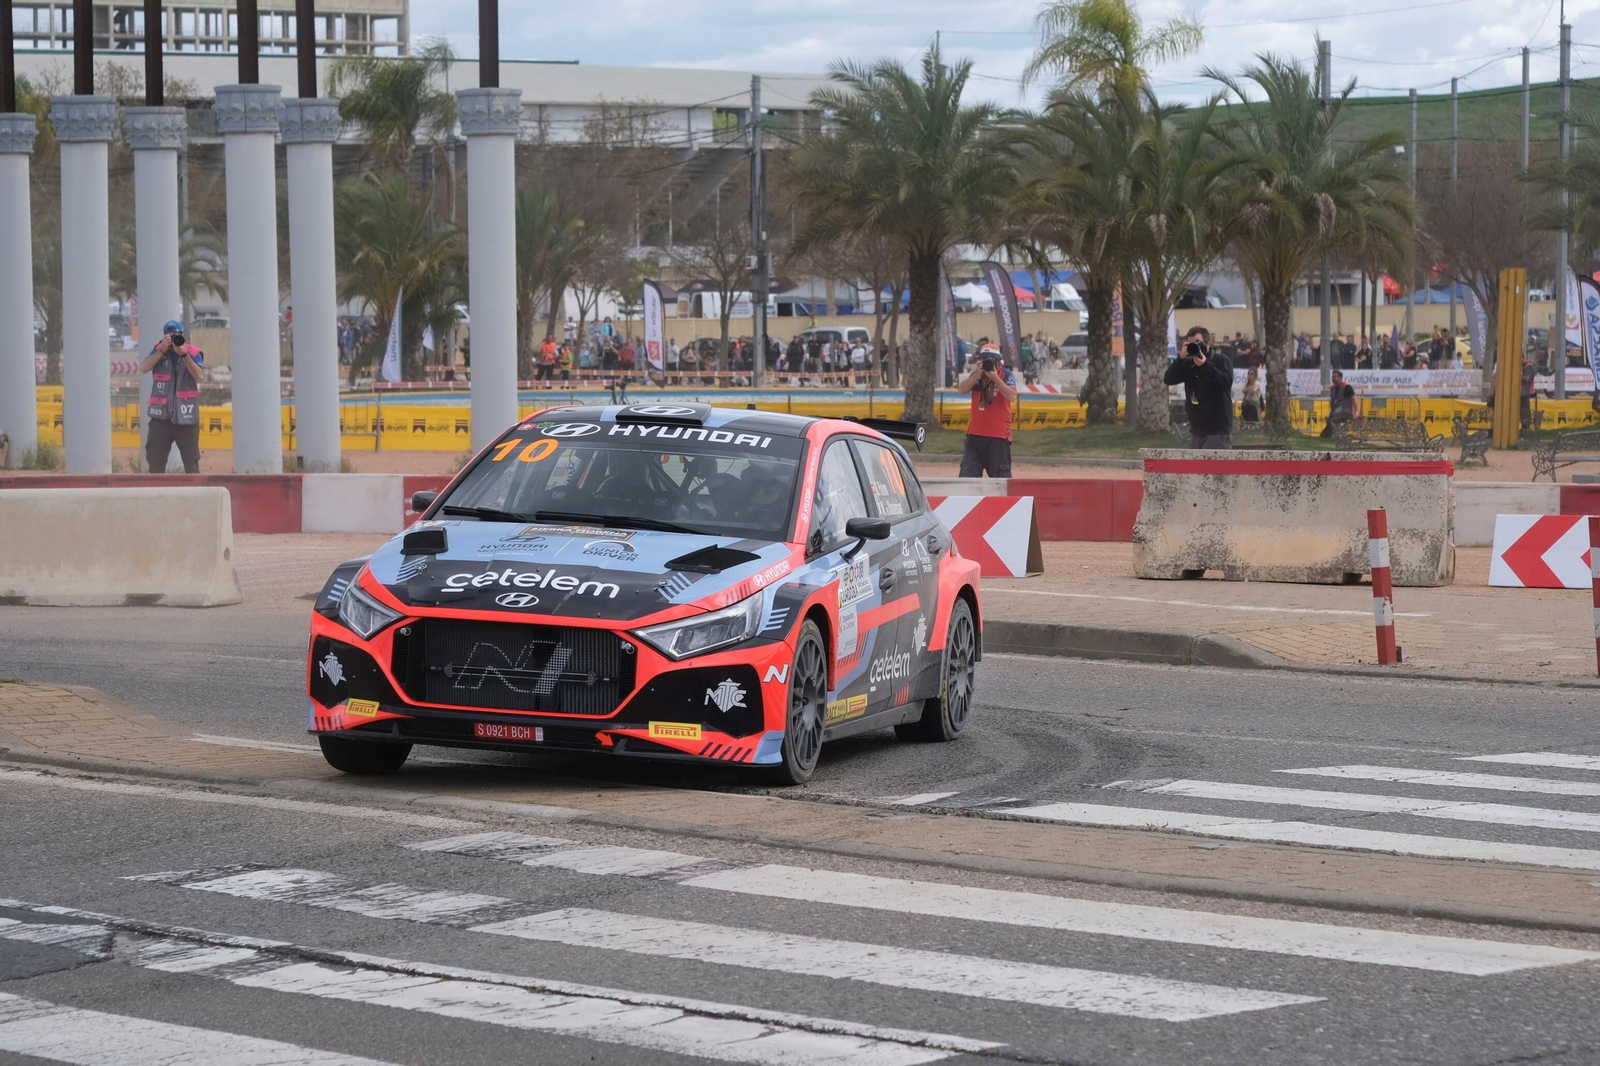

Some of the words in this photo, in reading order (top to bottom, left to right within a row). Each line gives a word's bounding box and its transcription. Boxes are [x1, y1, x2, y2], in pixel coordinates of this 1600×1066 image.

[156, 381, 166, 389] 07
[181, 404, 194, 414] 07
[608, 424, 772, 448] HYUNDAI
[491, 438, 559, 463] 10
[582, 550, 637, 562] DRIVER
[588, 546, 639, 559] JUNIOR
[763, 559, 791, 582] HYUNDAI
[441, 568, 620, 598] cetelem
[763, 664, 789, 684] N
[870, 643, 910, 691] cetelem
[349, 702, 376, 714] PIRELLI
[478, 723, 484, 736] S
[486, 724, 508, 737] 0921
[511, 726, 530, 738] BCH
[653, 724, 697, 738] PIRELLI
